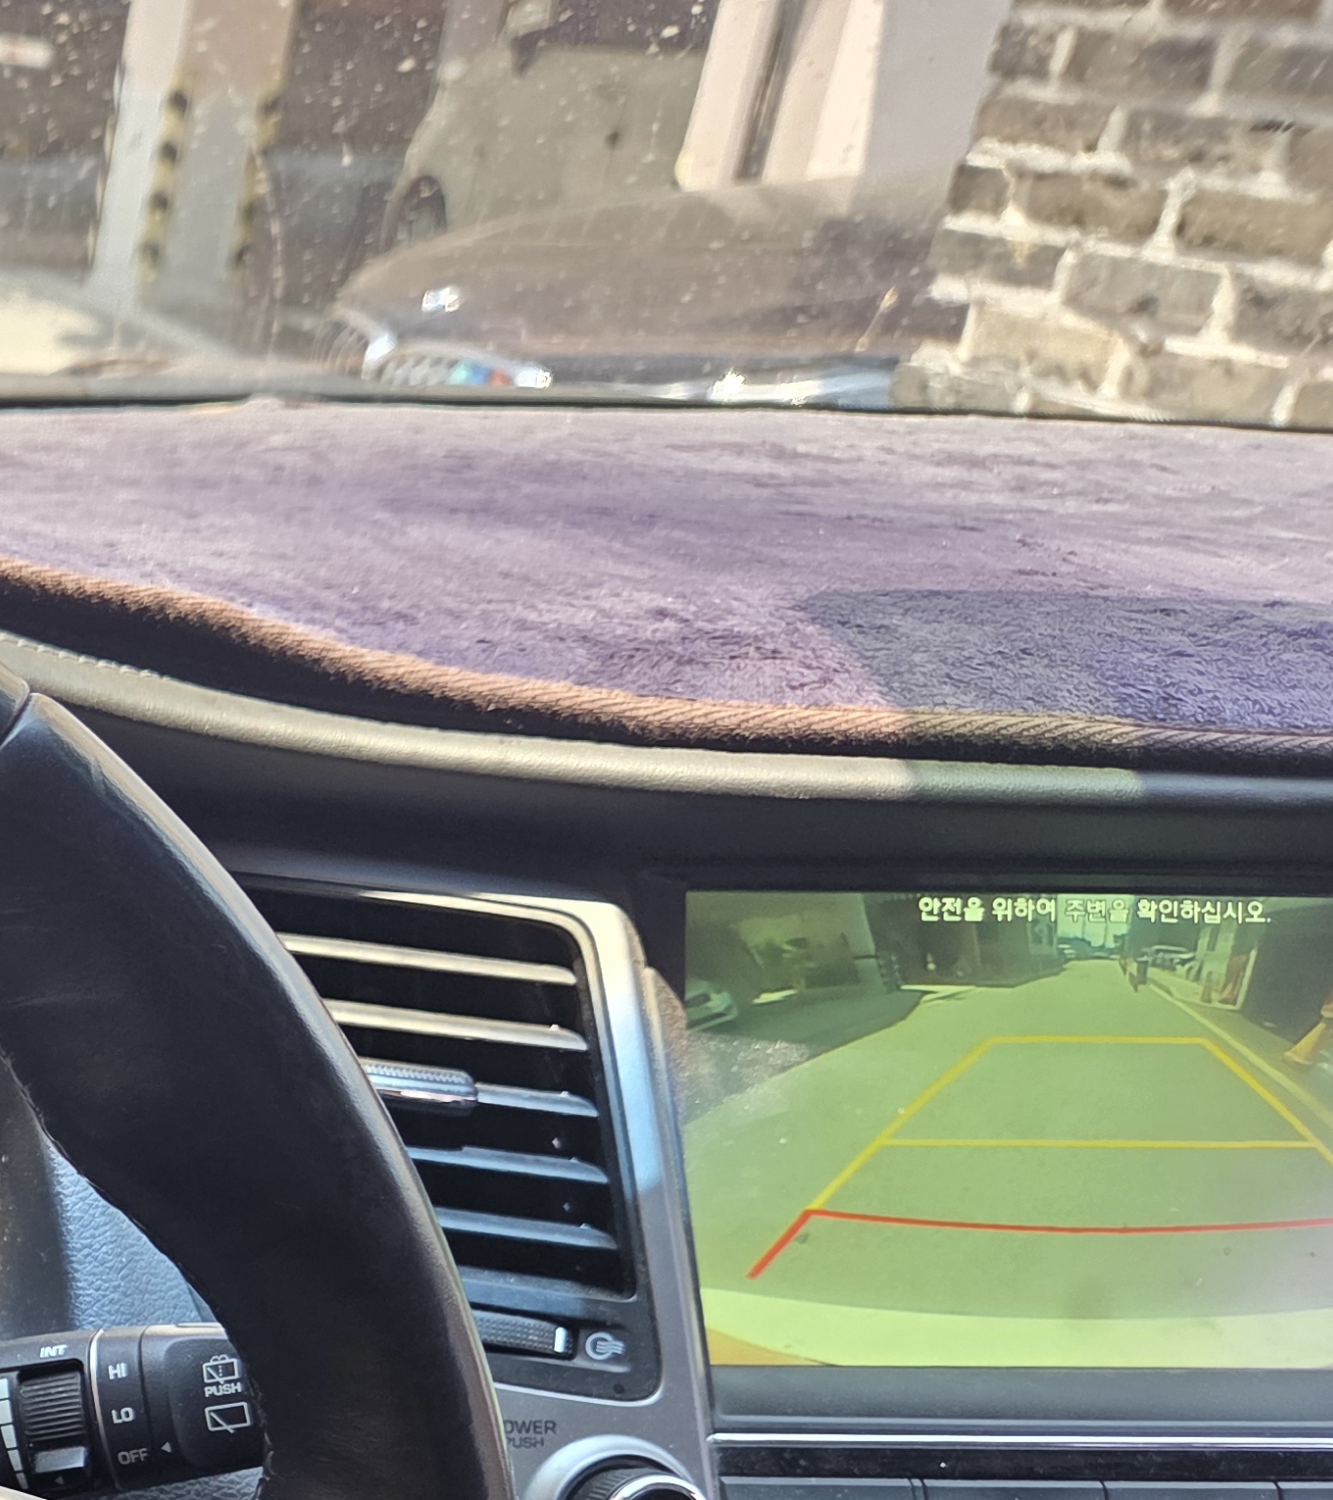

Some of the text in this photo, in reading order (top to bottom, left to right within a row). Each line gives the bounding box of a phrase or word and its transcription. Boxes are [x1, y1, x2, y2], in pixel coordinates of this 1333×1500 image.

[918, 897, 1272, 925] 안전을 위하여 주변을 확인하십시오.
[39, 1345, 68, 1357] INT
[108, 1363, 126, 1379] HI
[204, 1383, 242, 1398] PUSH
[111, 1407, 133, 1424] LO
[503, 1419, 557, 1435] OWER
[117, 1448, 149, 1465] OFF
